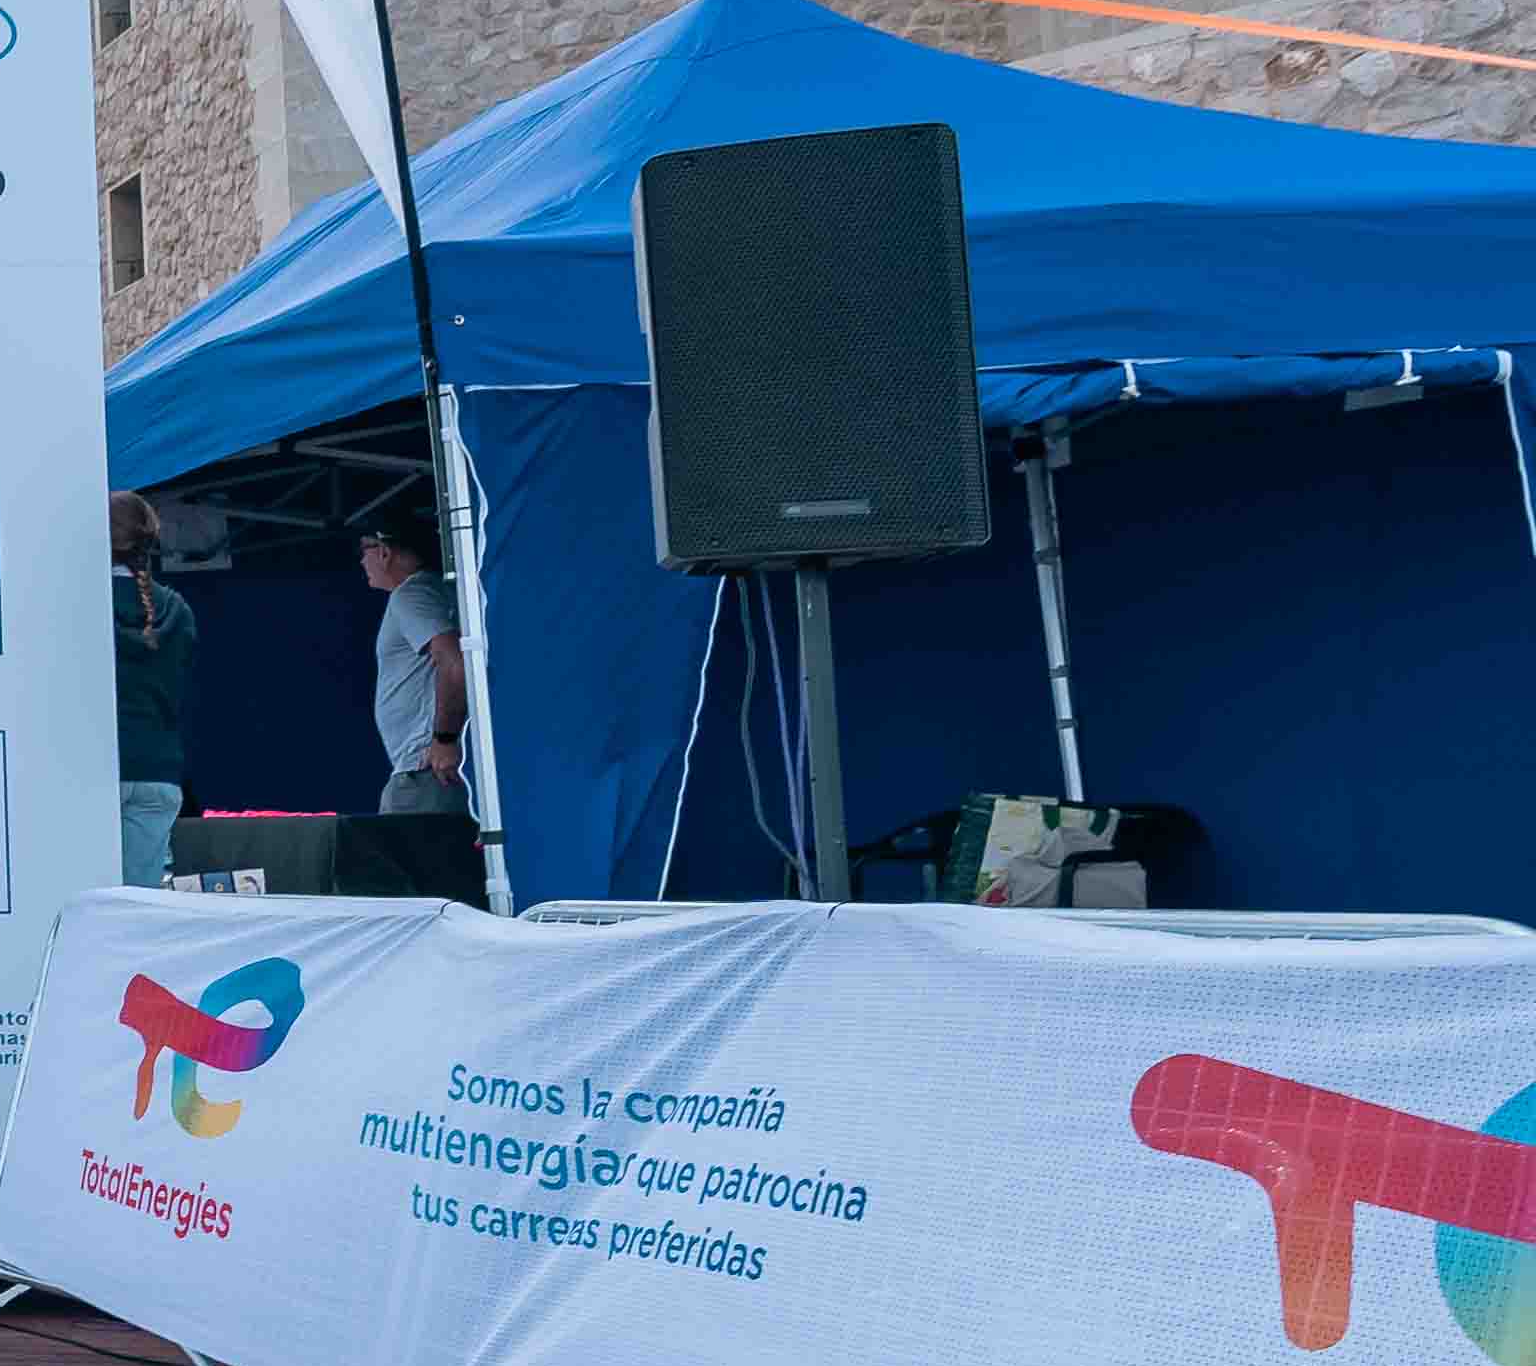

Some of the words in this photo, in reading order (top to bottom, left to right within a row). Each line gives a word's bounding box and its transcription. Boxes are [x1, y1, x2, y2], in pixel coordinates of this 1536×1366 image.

[448, 1064, 565, 1116] Somos
[582, 1078, 613, 1121] la
[81, 1148, 232, 1239] TotalEnergies
[638, 1153, 695, 1198] que
[699, 1162, 868, 1222] patrocina
[412, 1183, 458, 1228] tus
[608, 1219, 767, 1281] preferidas
